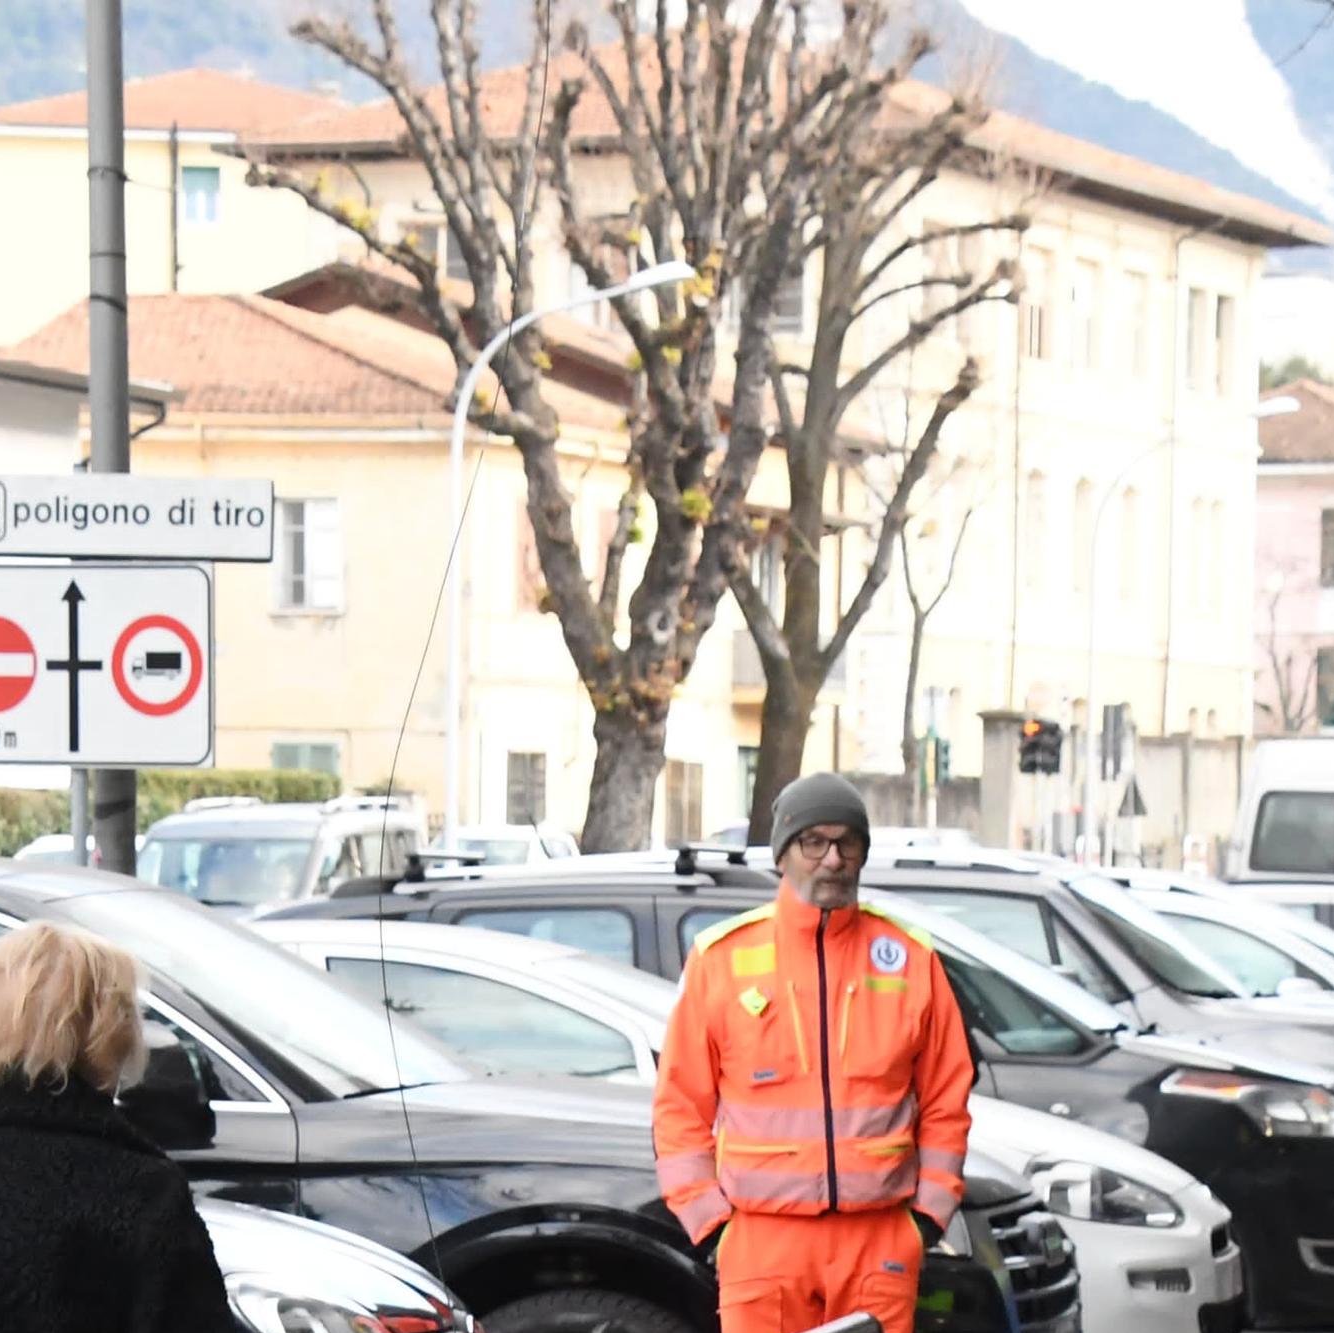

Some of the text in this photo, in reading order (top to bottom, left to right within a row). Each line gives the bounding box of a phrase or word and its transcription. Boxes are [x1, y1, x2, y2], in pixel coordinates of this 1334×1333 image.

[13, 496, 266, 531] poligono di tiro
[4, 731, 18, 748] m
